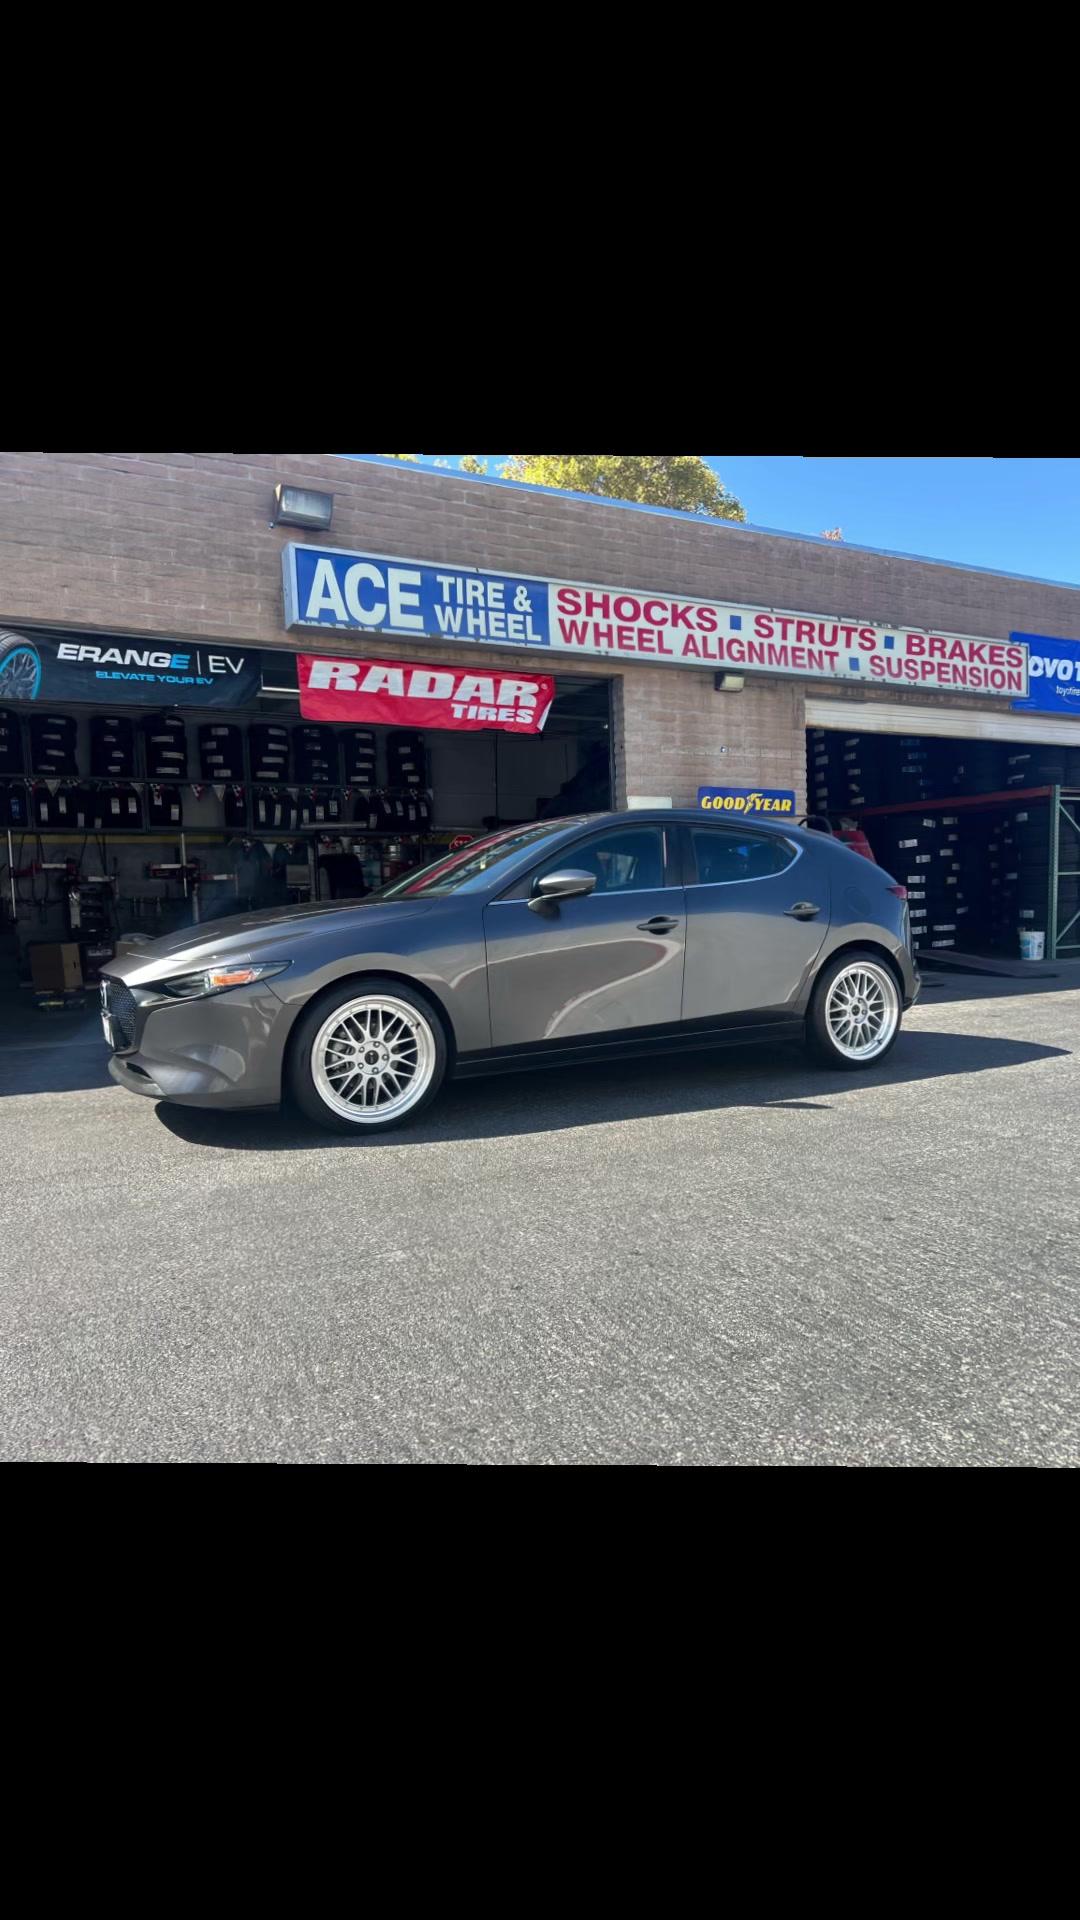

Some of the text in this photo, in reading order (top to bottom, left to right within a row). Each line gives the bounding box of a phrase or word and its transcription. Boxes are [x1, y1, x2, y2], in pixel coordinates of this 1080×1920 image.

[306, 558, 424, 630] ACE
[436, 575, 533, 613] TIRE &
[557, 588, 718, 633] SHOCKS
[434, 604, 542, 642] WHEEL
[754, 614, 877, 652] STRUTS
[57, 643, 245, 674] ERANGE EV
[558, 617, 839, 673] WHEEL ALIGNMENT
[906, 633, 1023, 668] BRAKES
[96, 671, 155, 681] ELEVATE
[157, 675, 194, 684] YOUR
[307, 660, 540, 708] RADAR
[869, 655, 1022, 691] SUSPENSION
[451, 703, 534, 724] TIRES
